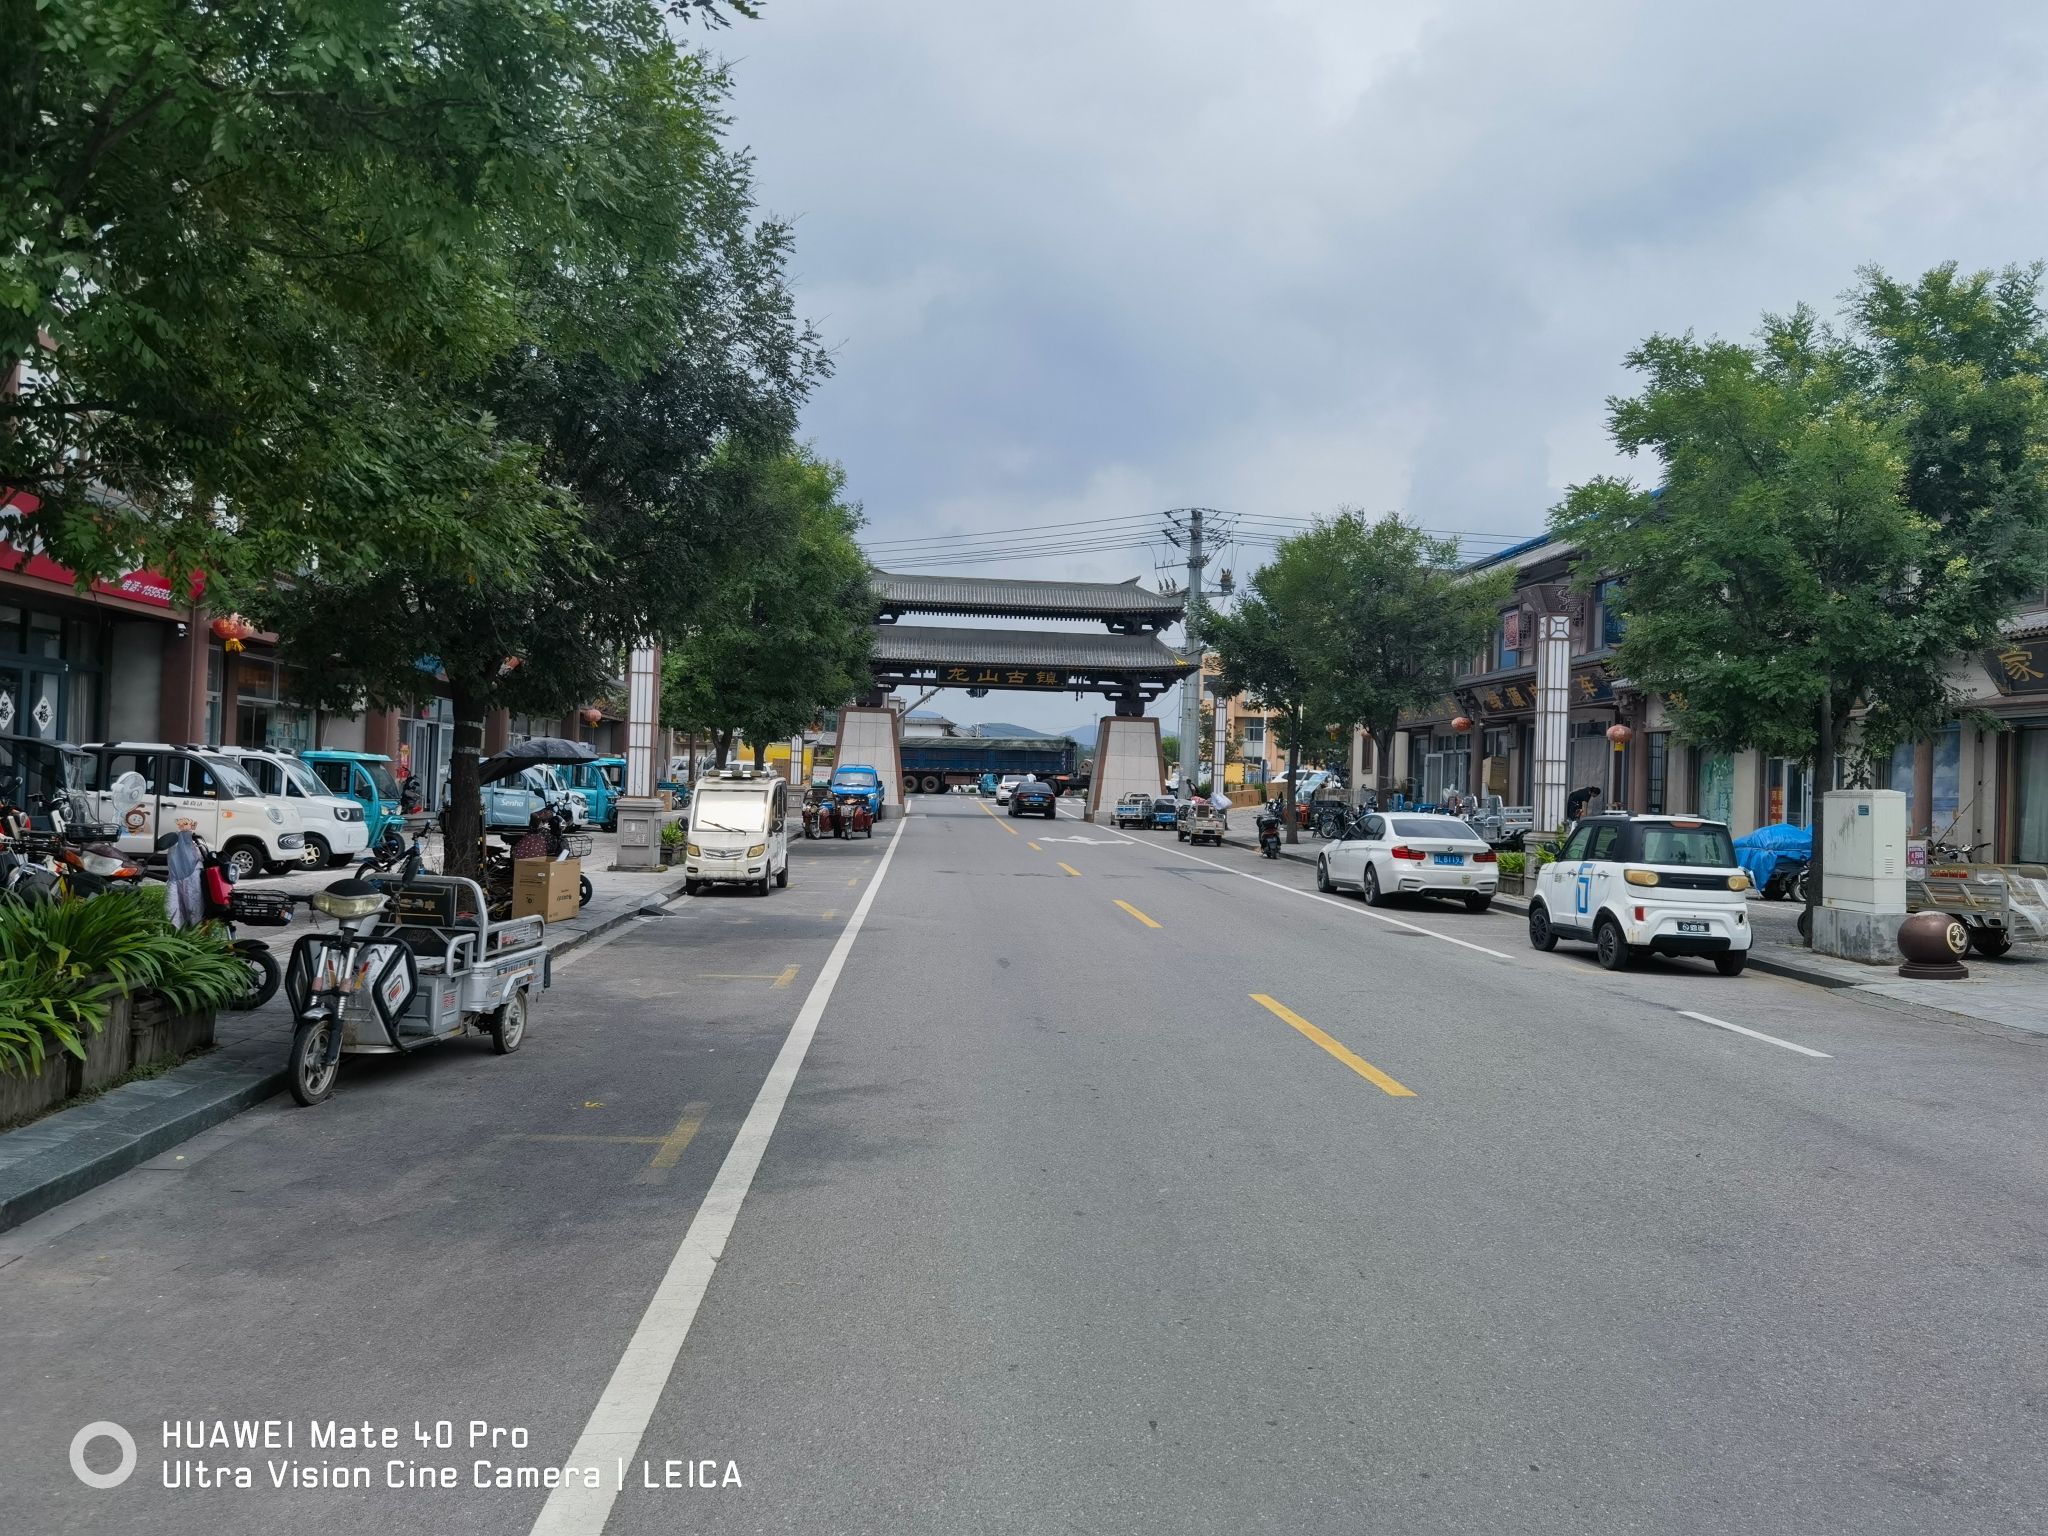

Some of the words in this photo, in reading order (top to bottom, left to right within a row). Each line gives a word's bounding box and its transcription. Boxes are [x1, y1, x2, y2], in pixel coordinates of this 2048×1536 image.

[946, 667, 1058, 685] 龙山古镇
[1998, 650, 2045, 682] 家
[1487, 675, 1599, 710] 绿源车
